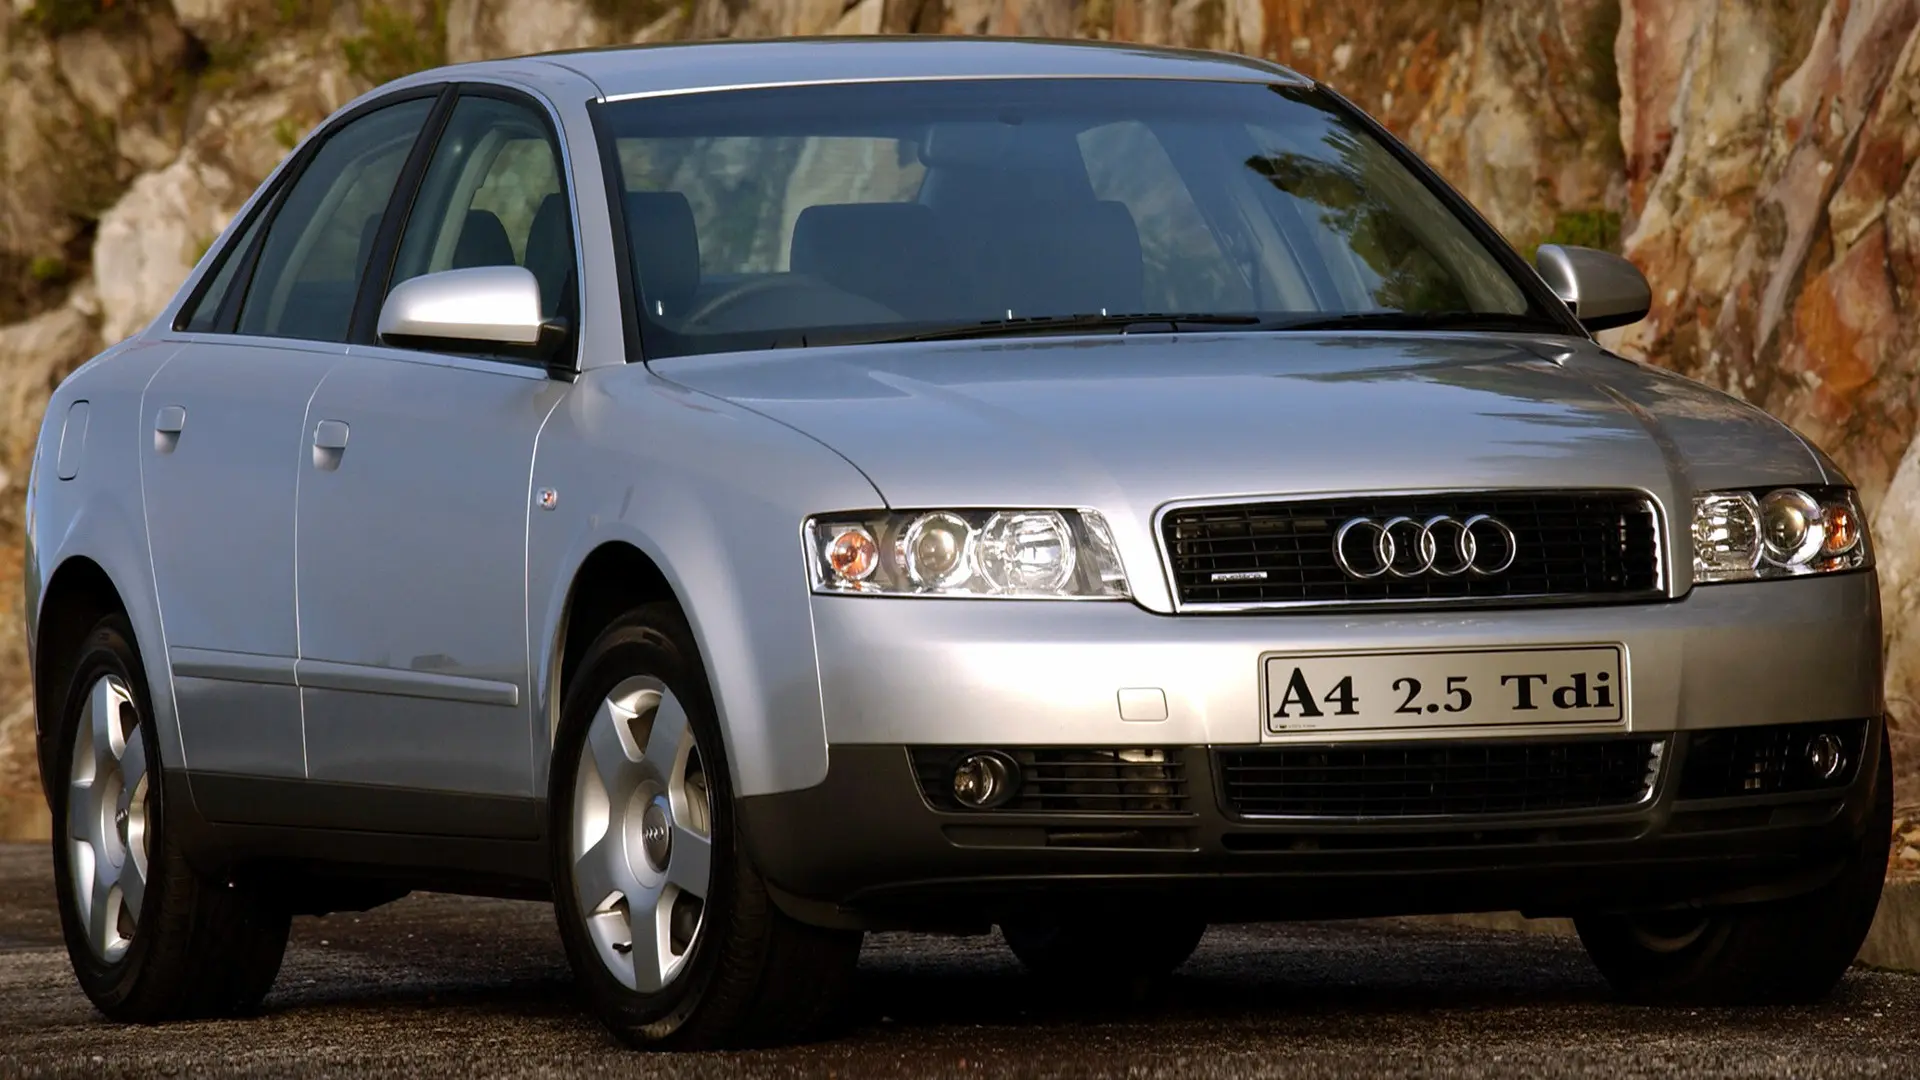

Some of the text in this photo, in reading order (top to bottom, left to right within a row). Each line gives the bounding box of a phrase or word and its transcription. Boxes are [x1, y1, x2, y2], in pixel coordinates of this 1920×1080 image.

[1273, 667, 1615, 718] A4 2.5 Tdi
